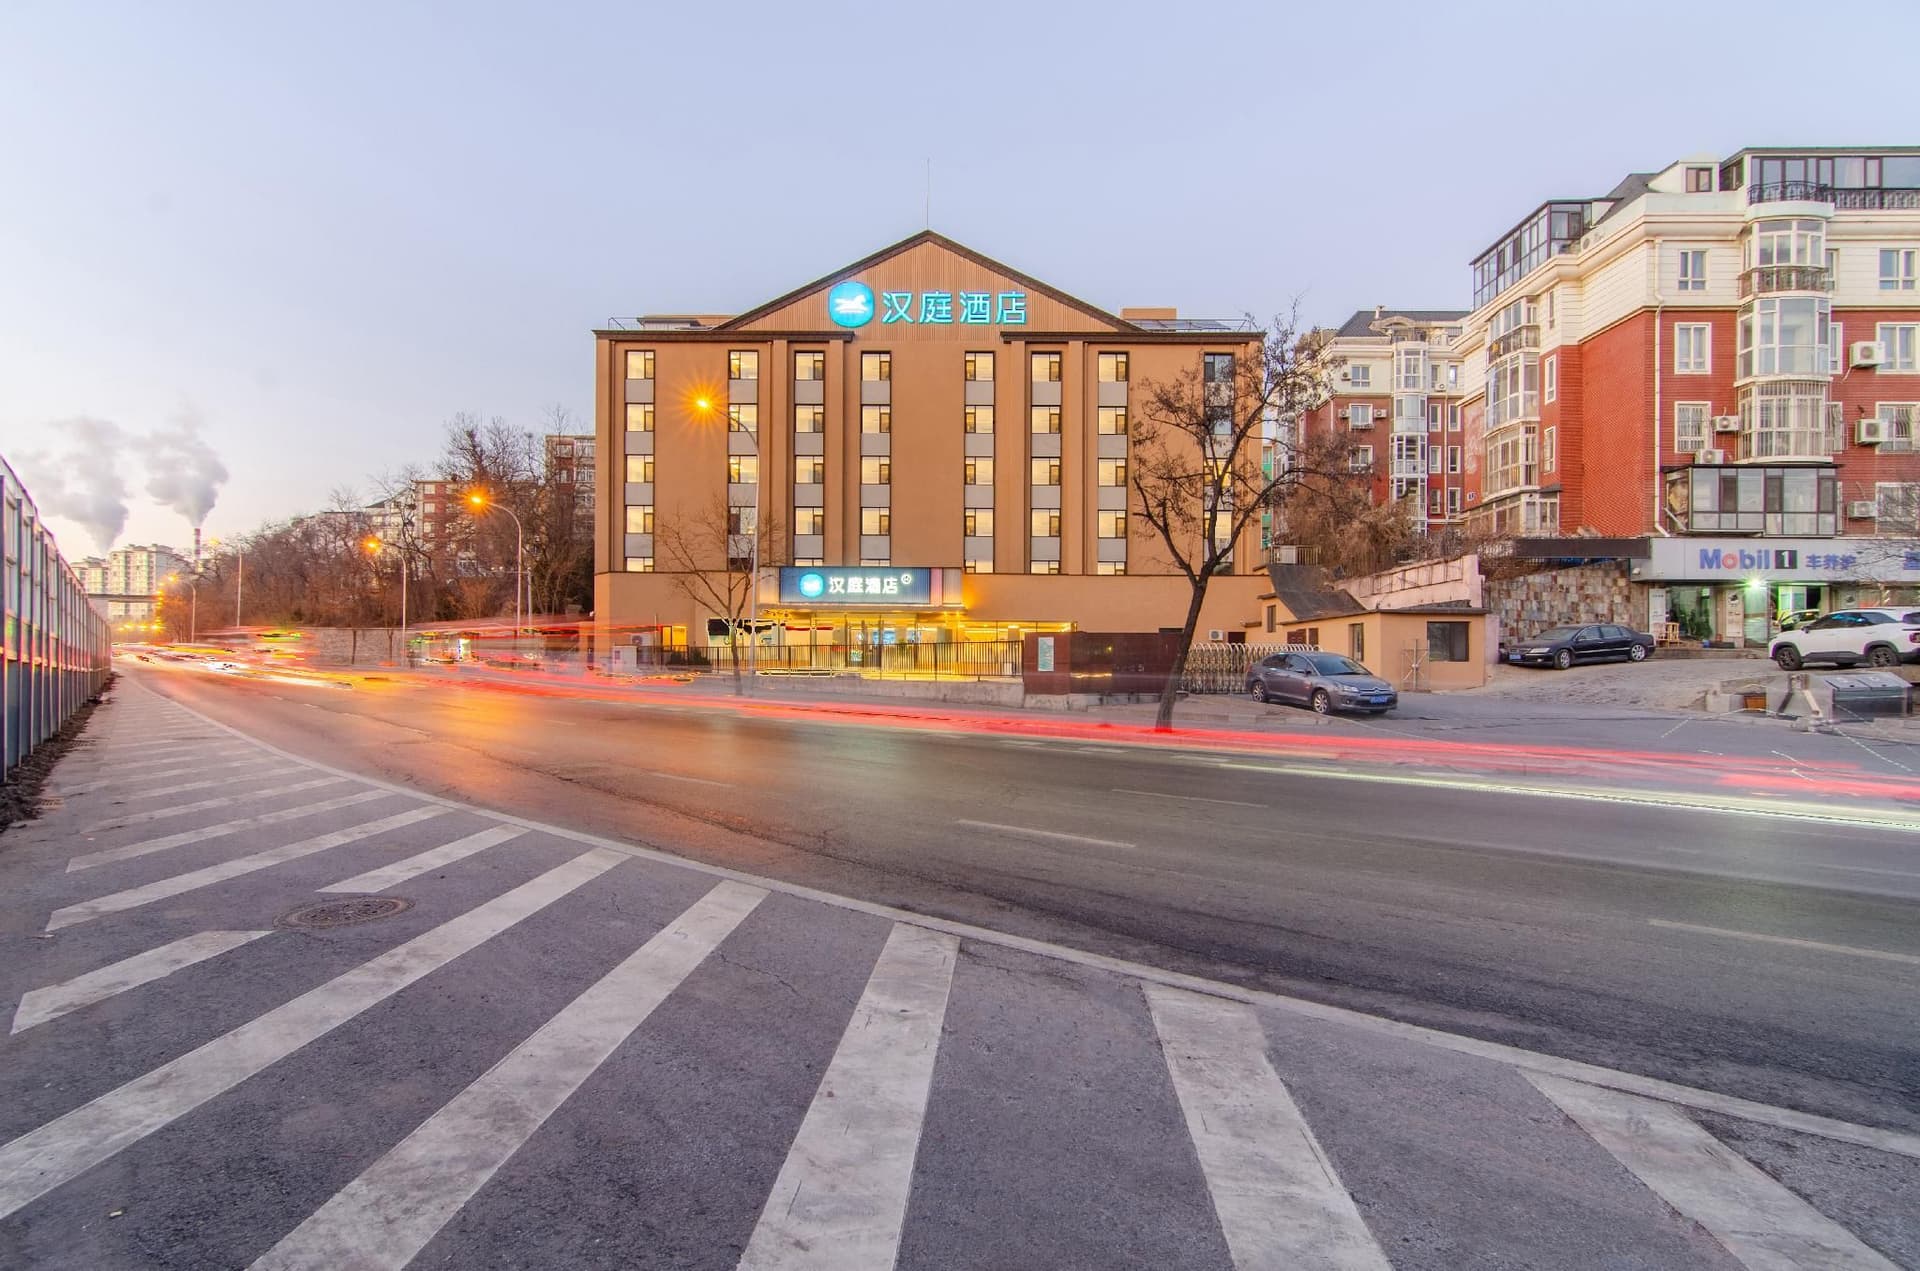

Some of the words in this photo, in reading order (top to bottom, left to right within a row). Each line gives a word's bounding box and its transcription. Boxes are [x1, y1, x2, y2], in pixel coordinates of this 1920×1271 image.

[882, 291, 1027, 324] 汉庭酒店
[1699, 548, 1770, 569] Mobil
[828, 576, 898, 595] 汉庭酒店
